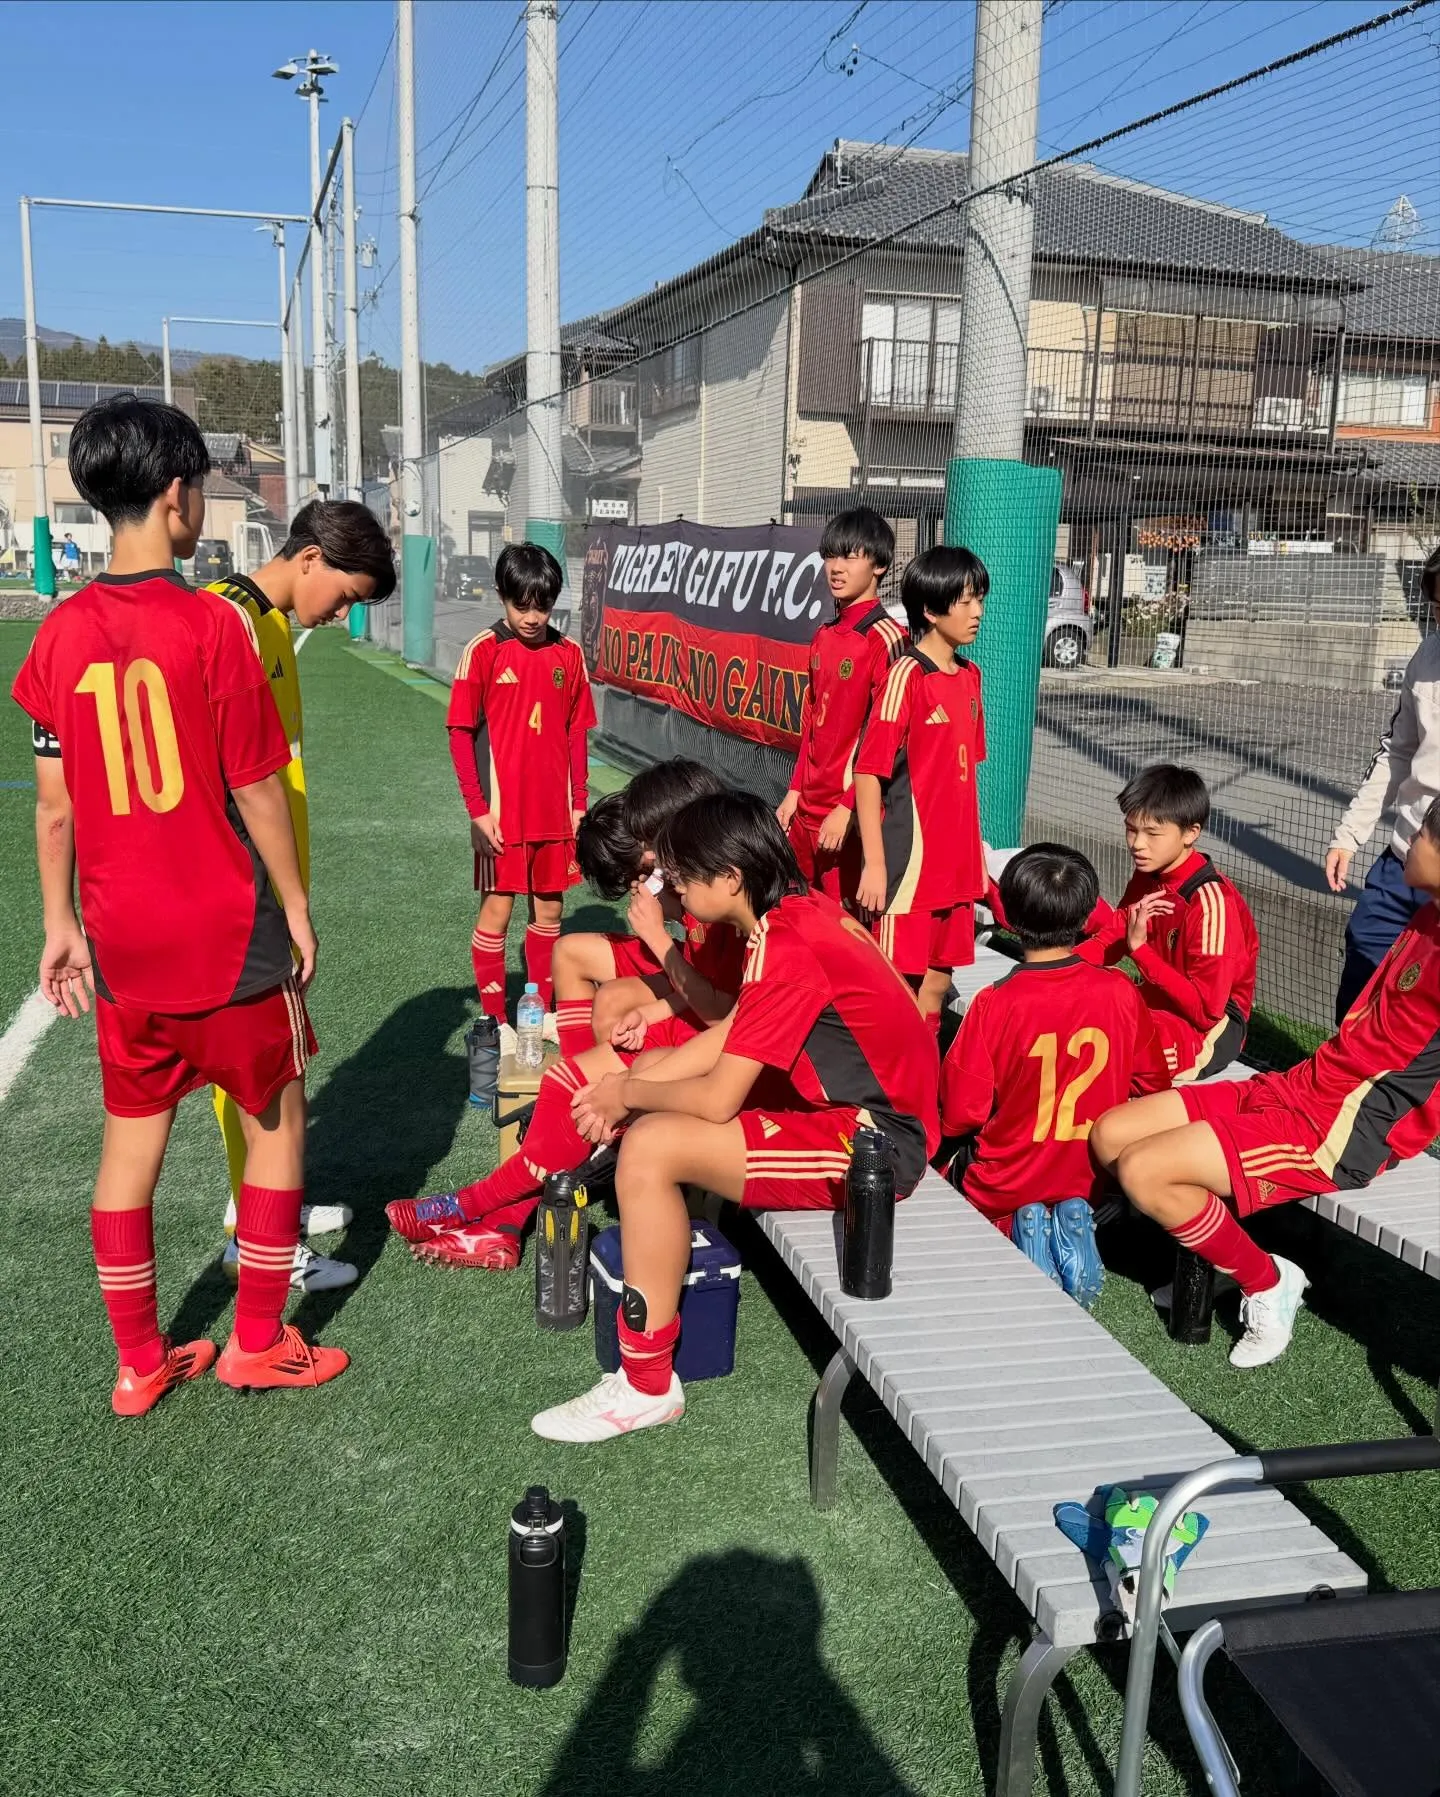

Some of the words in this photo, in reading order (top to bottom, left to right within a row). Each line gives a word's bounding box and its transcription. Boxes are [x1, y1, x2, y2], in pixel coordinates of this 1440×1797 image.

[608, 541, 694, 595] TIGREY
[685, 548, 770, 612] GIFU
[760, 551, 825, 620] F.C.
[528, 701, 542, 736] 4
[602, 624, 622, 677] NO
[687, 645, 719, 711] NO
[723, 656, 809, 736] GAIN
[74, 658, 184, 815] 10
[958, 743, 968, 783] 9
[1027, 1027, 1110, 1142] 12
